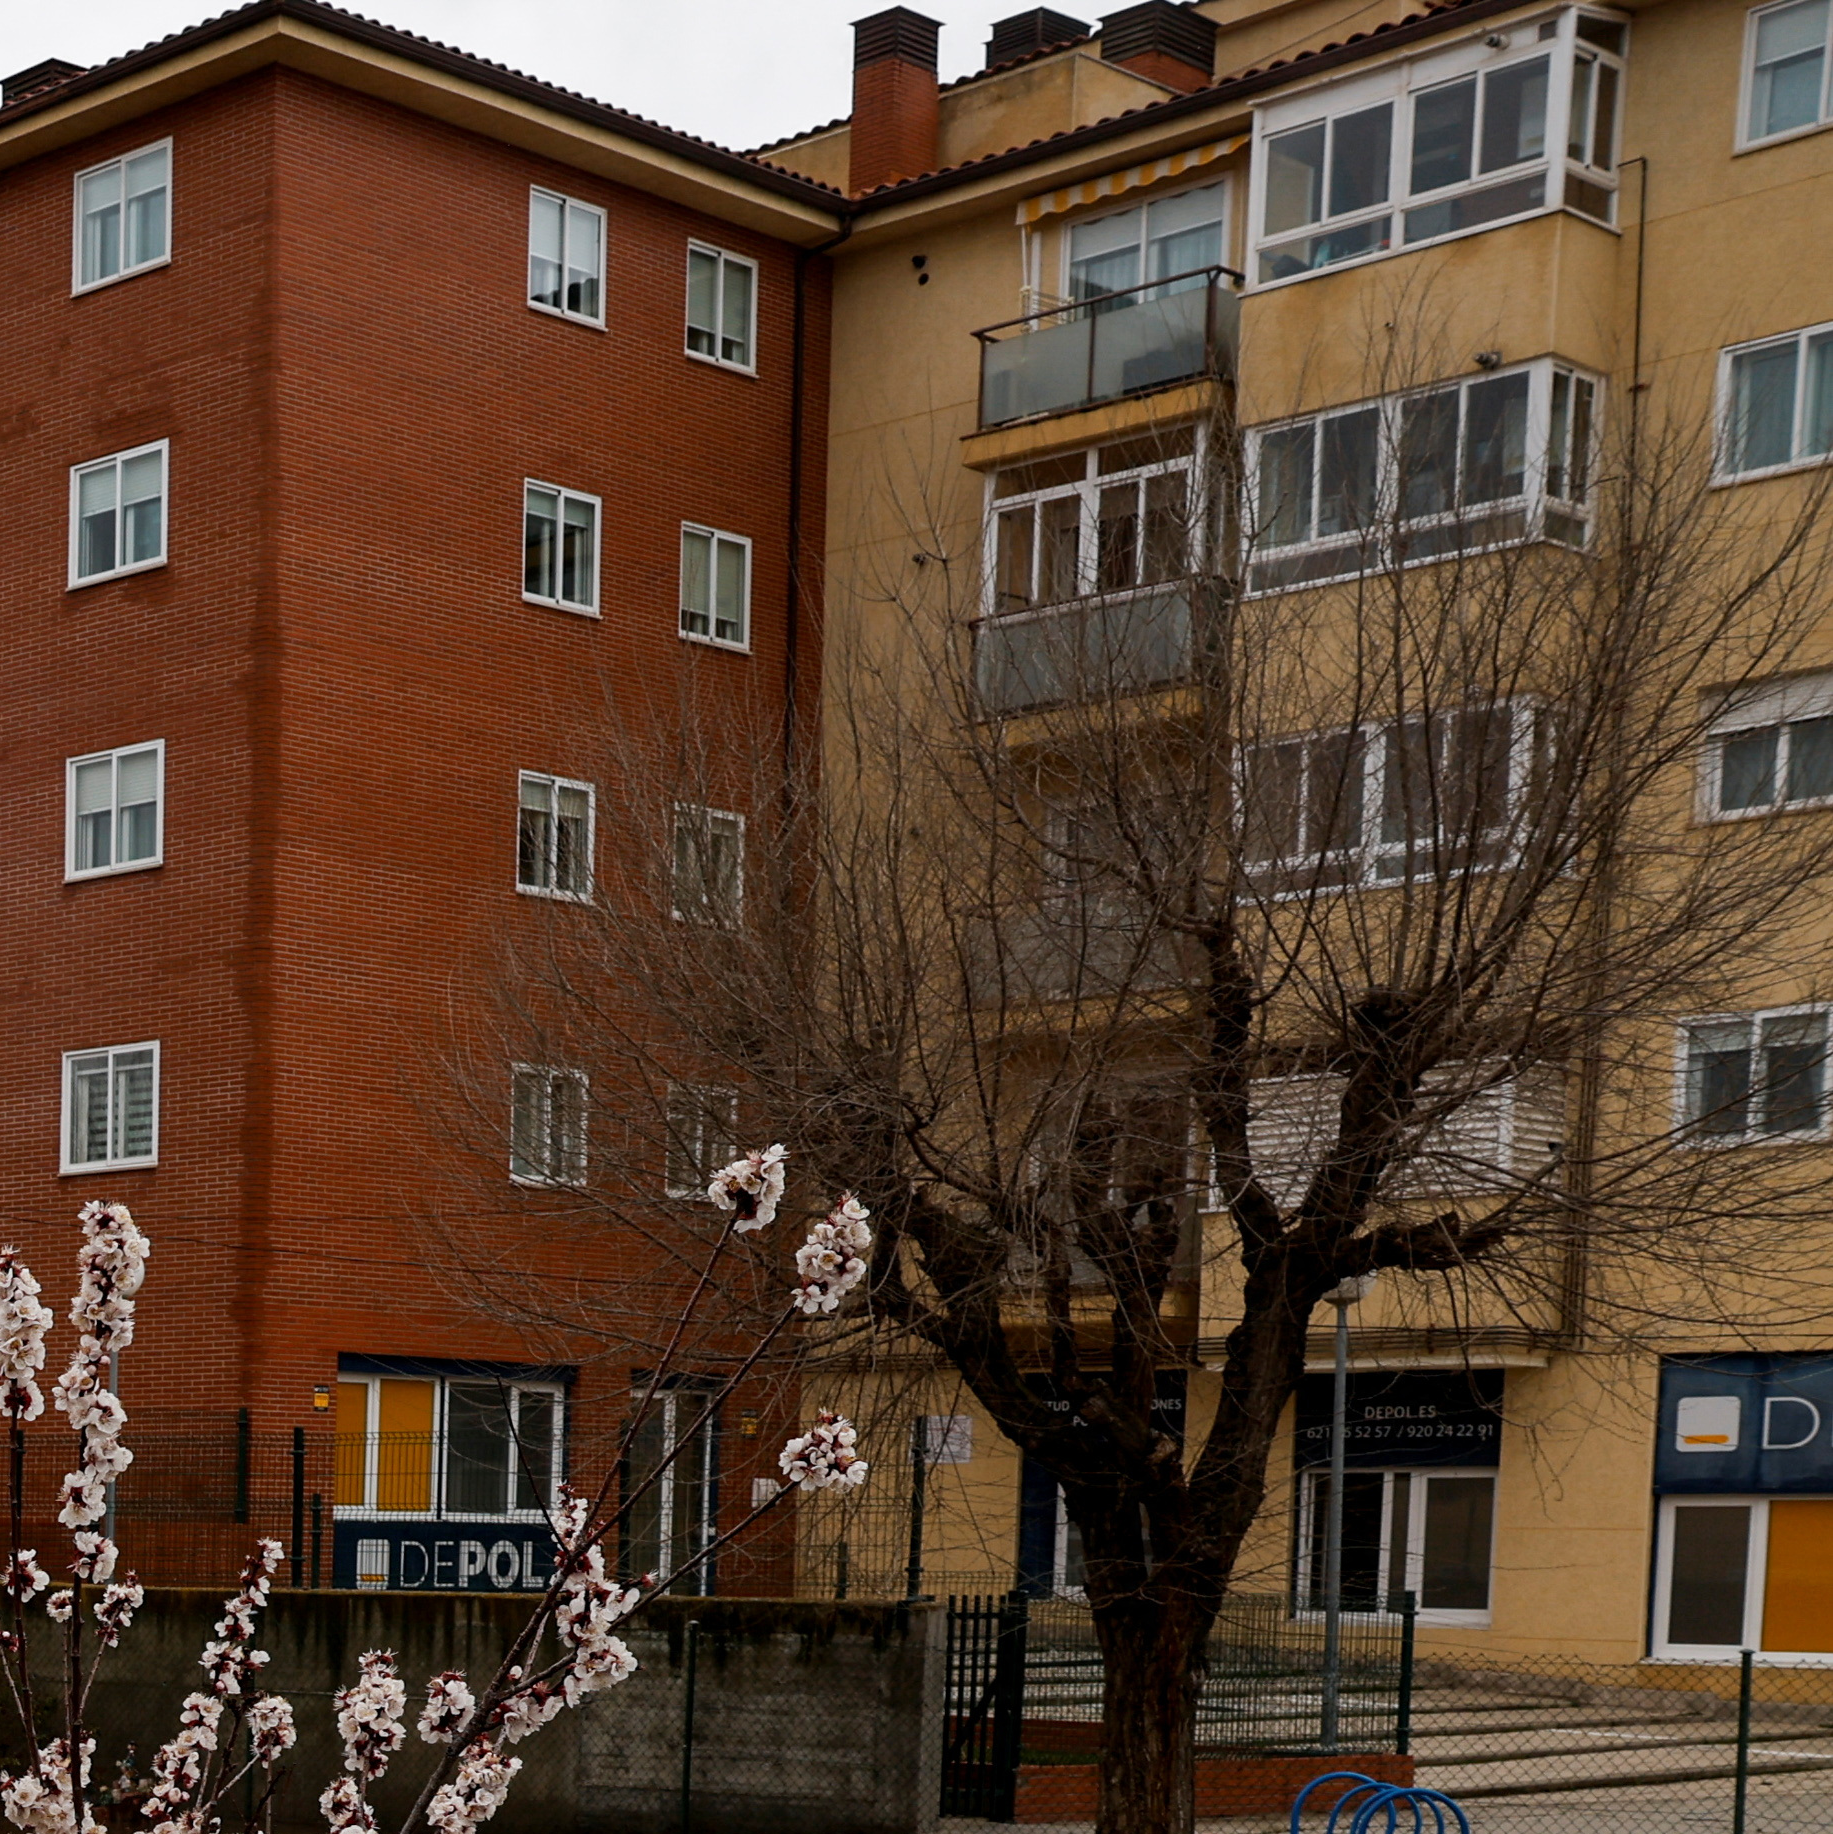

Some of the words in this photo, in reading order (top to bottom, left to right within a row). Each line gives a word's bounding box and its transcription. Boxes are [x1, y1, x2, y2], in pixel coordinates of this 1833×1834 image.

[1355, 1426, 1371, 1438] 52
[1374, 1425, 1391, 1438] 57
[1407, 1425, 1433, 1437] 920
[1436, 1425, 1453, 1437] 24
[1456, 1424, 1473, 1437] 22
[1762, 1396, 1833, 1450] D
[400, 1540, 545, 1589] DEPOL
